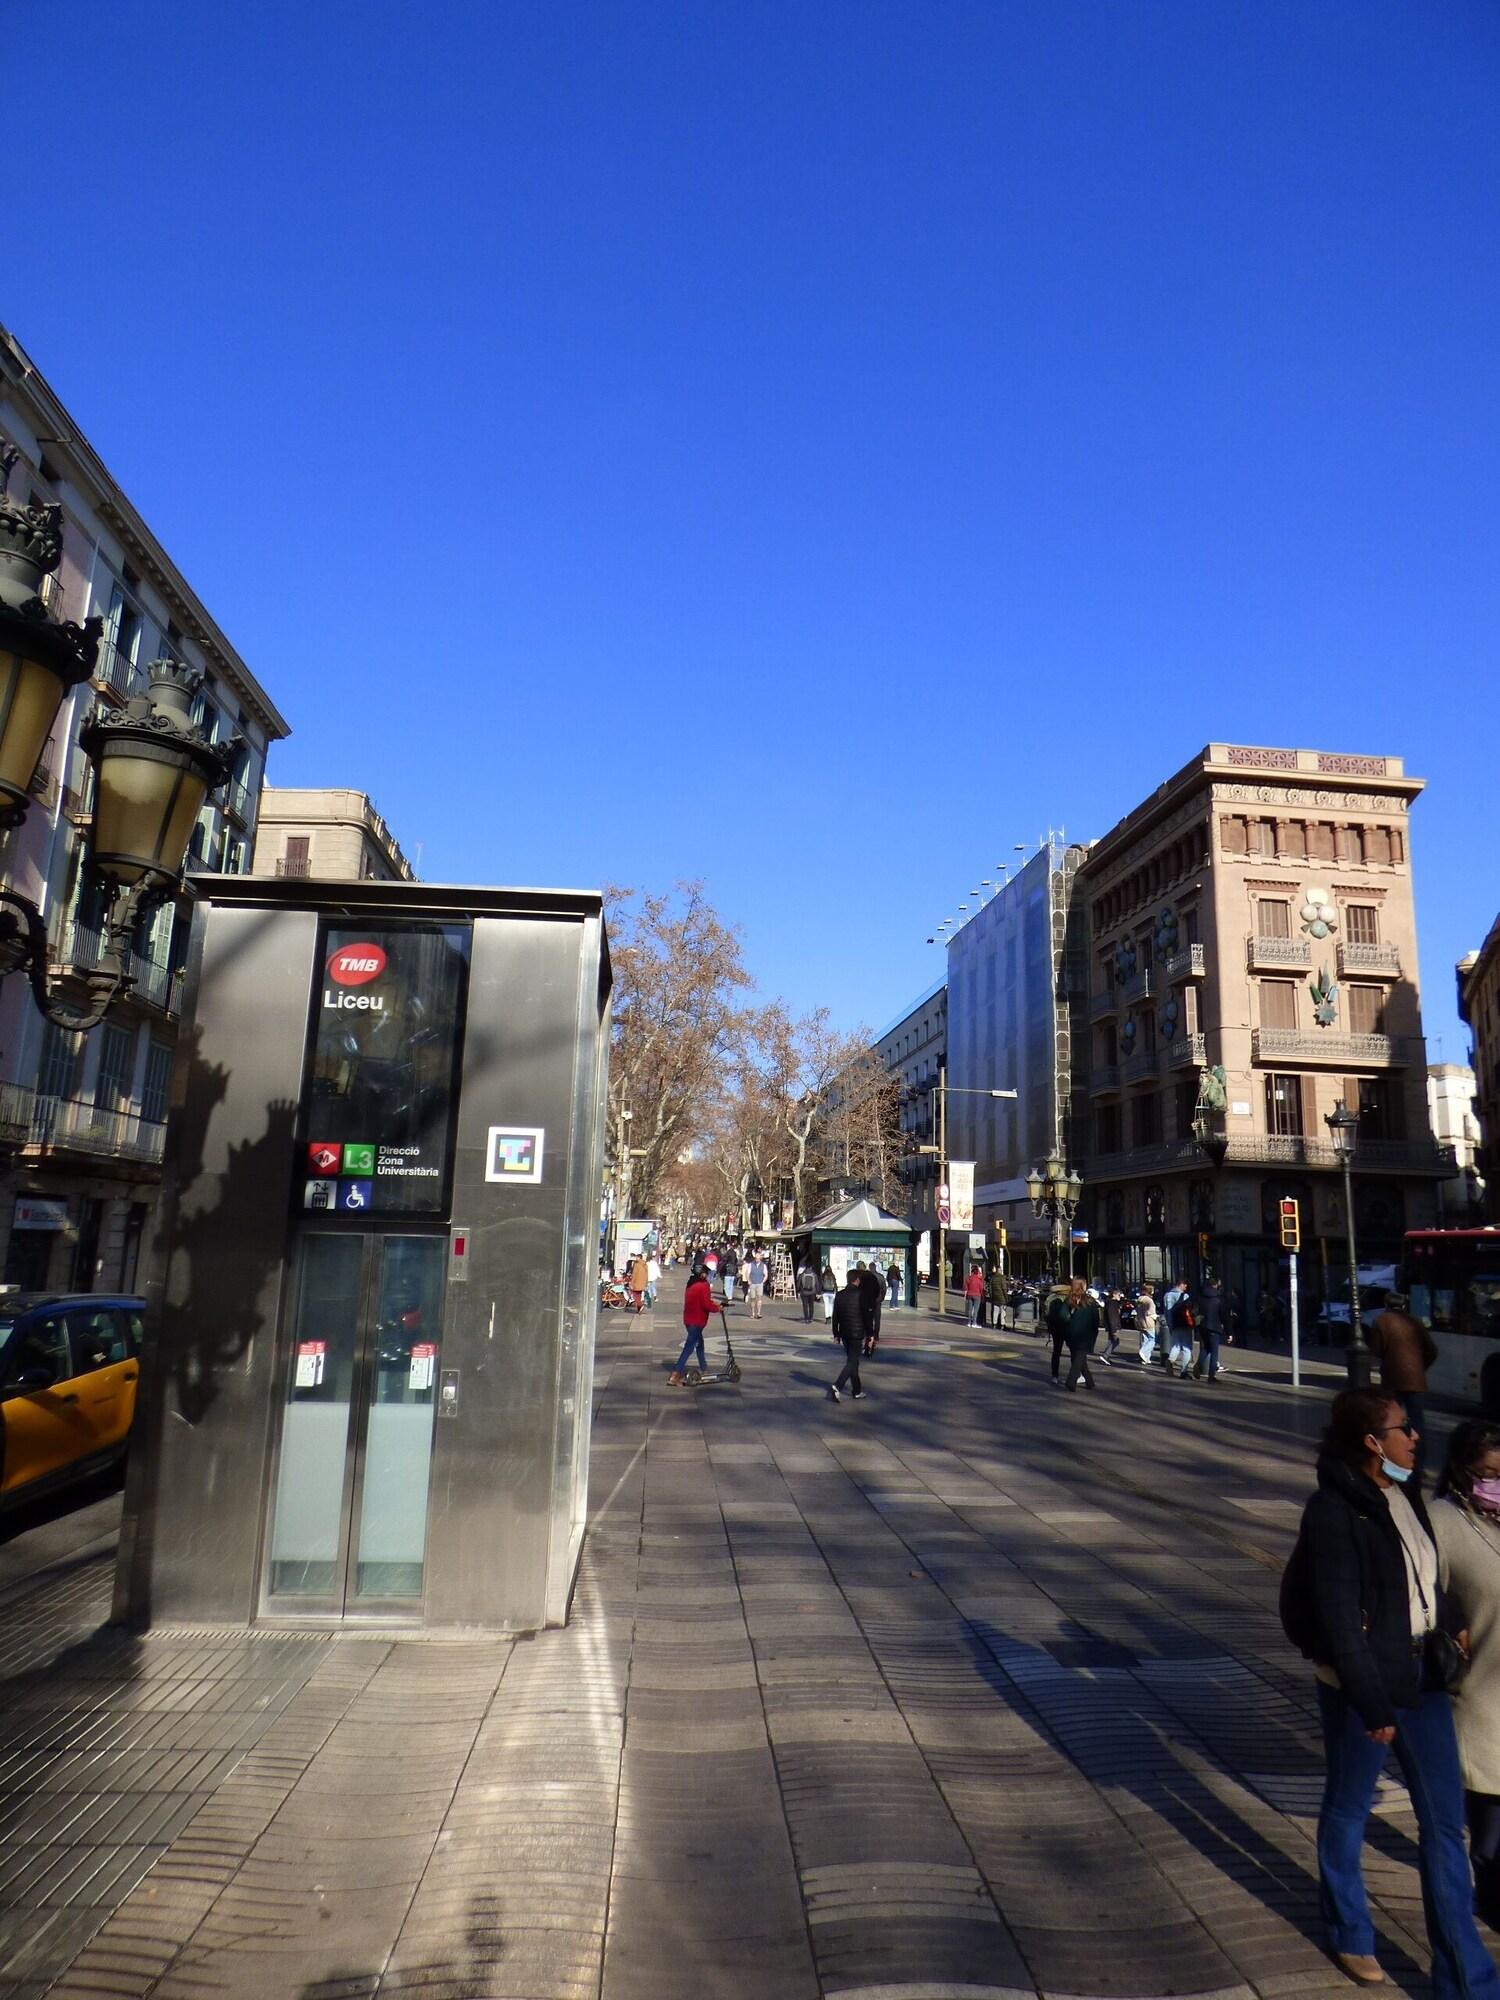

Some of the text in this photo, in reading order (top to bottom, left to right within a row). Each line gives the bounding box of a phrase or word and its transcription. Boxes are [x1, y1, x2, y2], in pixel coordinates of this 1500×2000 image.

[339, 958, 379, 972] TMB
[324, 990, 384, 1010] Liceu
[379, 1146, 420, 1156] Direcció
[345, 1150, 372, 1169] L3
[377, 1156, 404, 1166] Zona
[377, 1166, 439, 1177] Universitària
